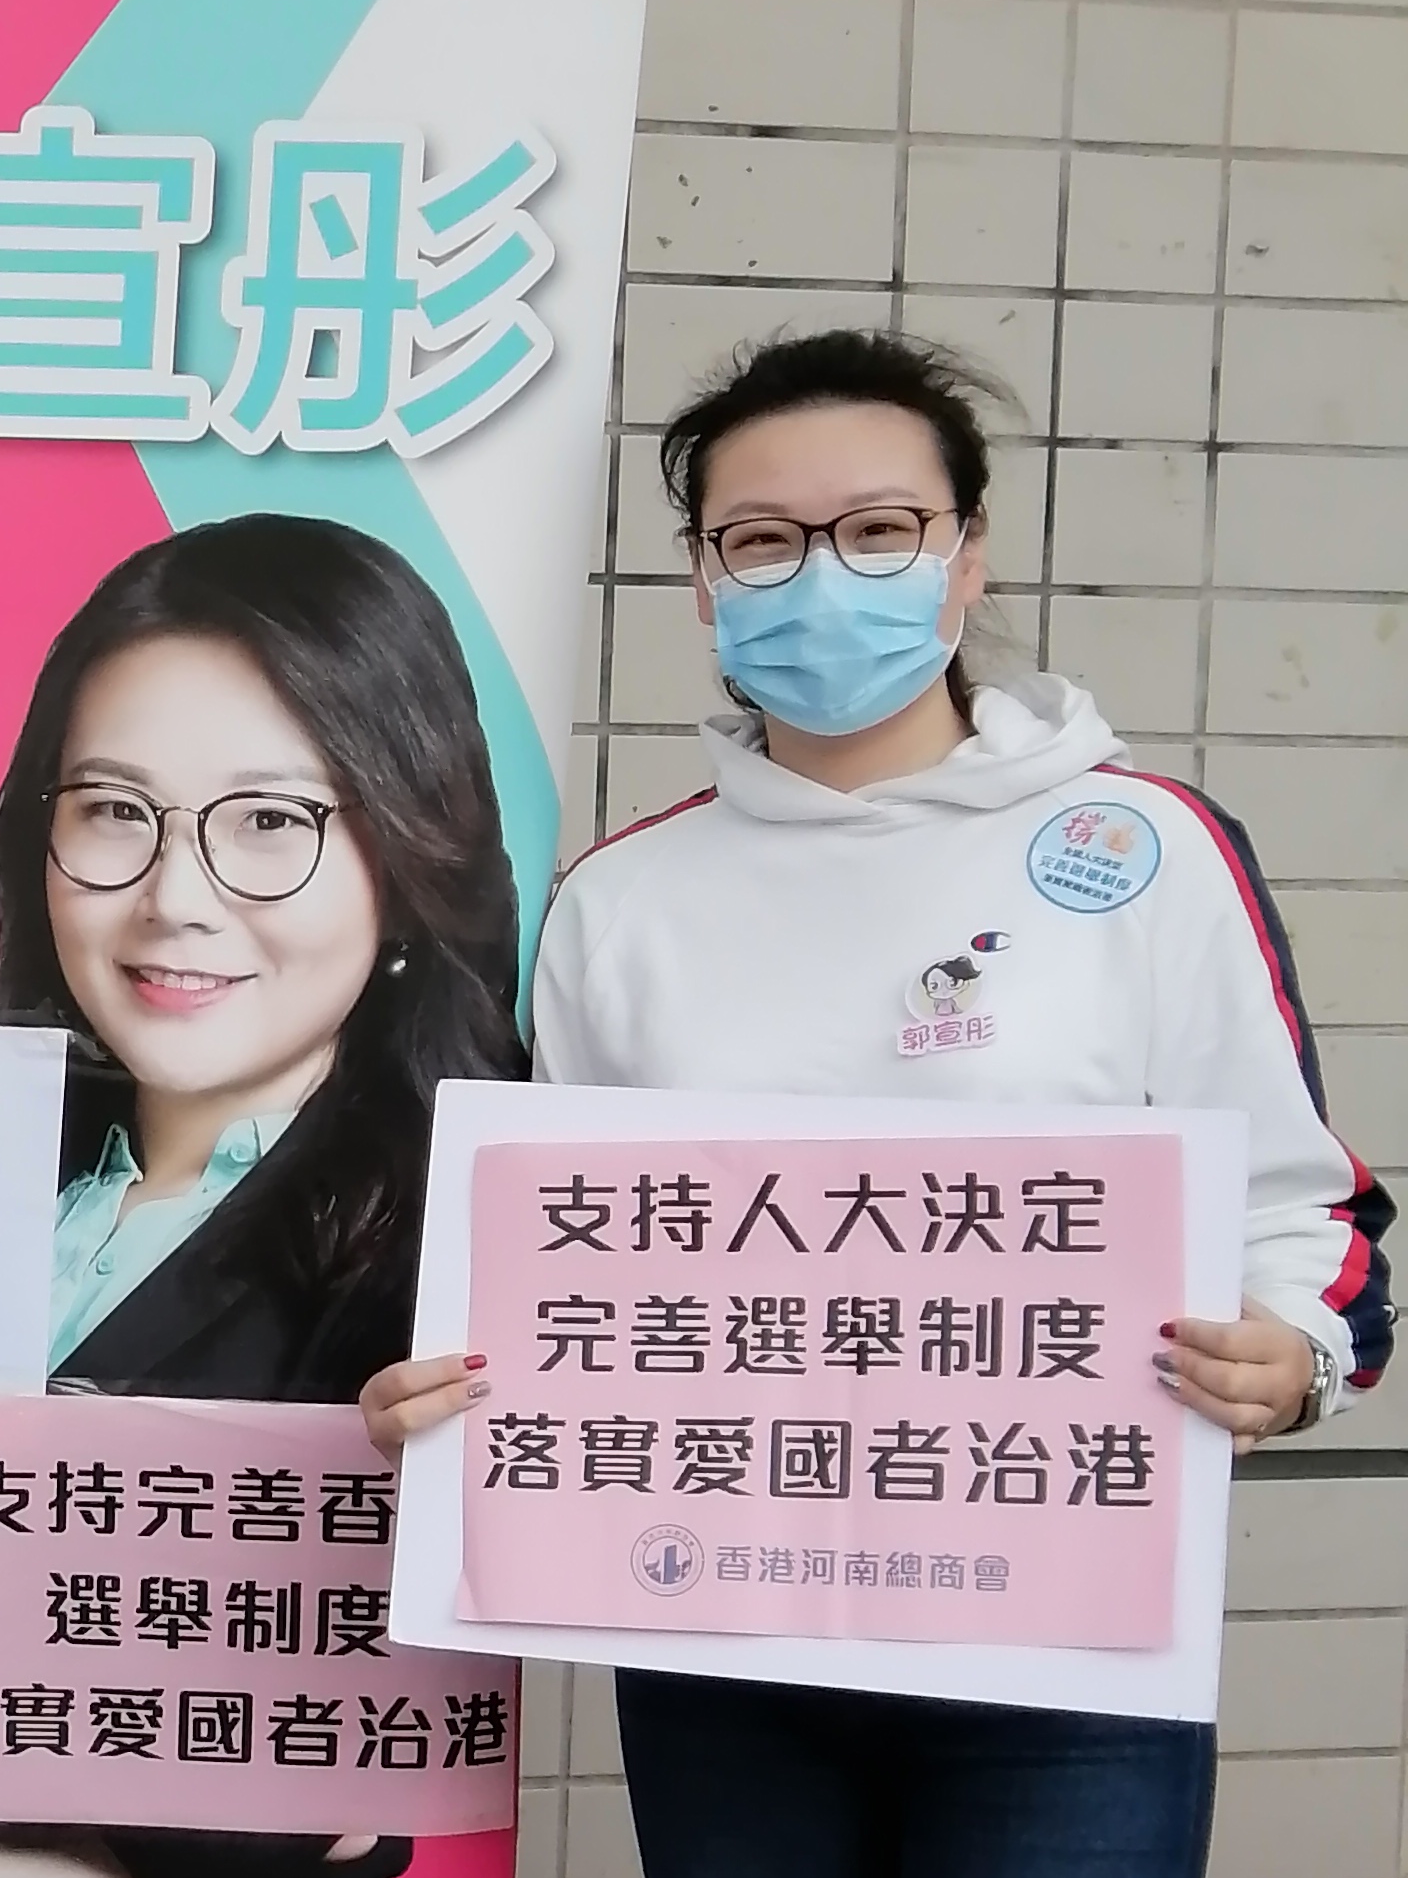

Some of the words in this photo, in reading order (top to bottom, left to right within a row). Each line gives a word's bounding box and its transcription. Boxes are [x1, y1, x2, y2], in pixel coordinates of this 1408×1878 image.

[902, 1015, 996, 1049] 郭宣彤
[538, 1170, 1108, 1257] 支持人大決定
[535, 1294, 1106, 1379] 完善選舉制度
[483, 1413, 1155, 1510] 落實愛國者治港
[716, 1545, 1010, 1592] 香港河南總商會
[46, 1571, 391, 1658] 選舉制度
